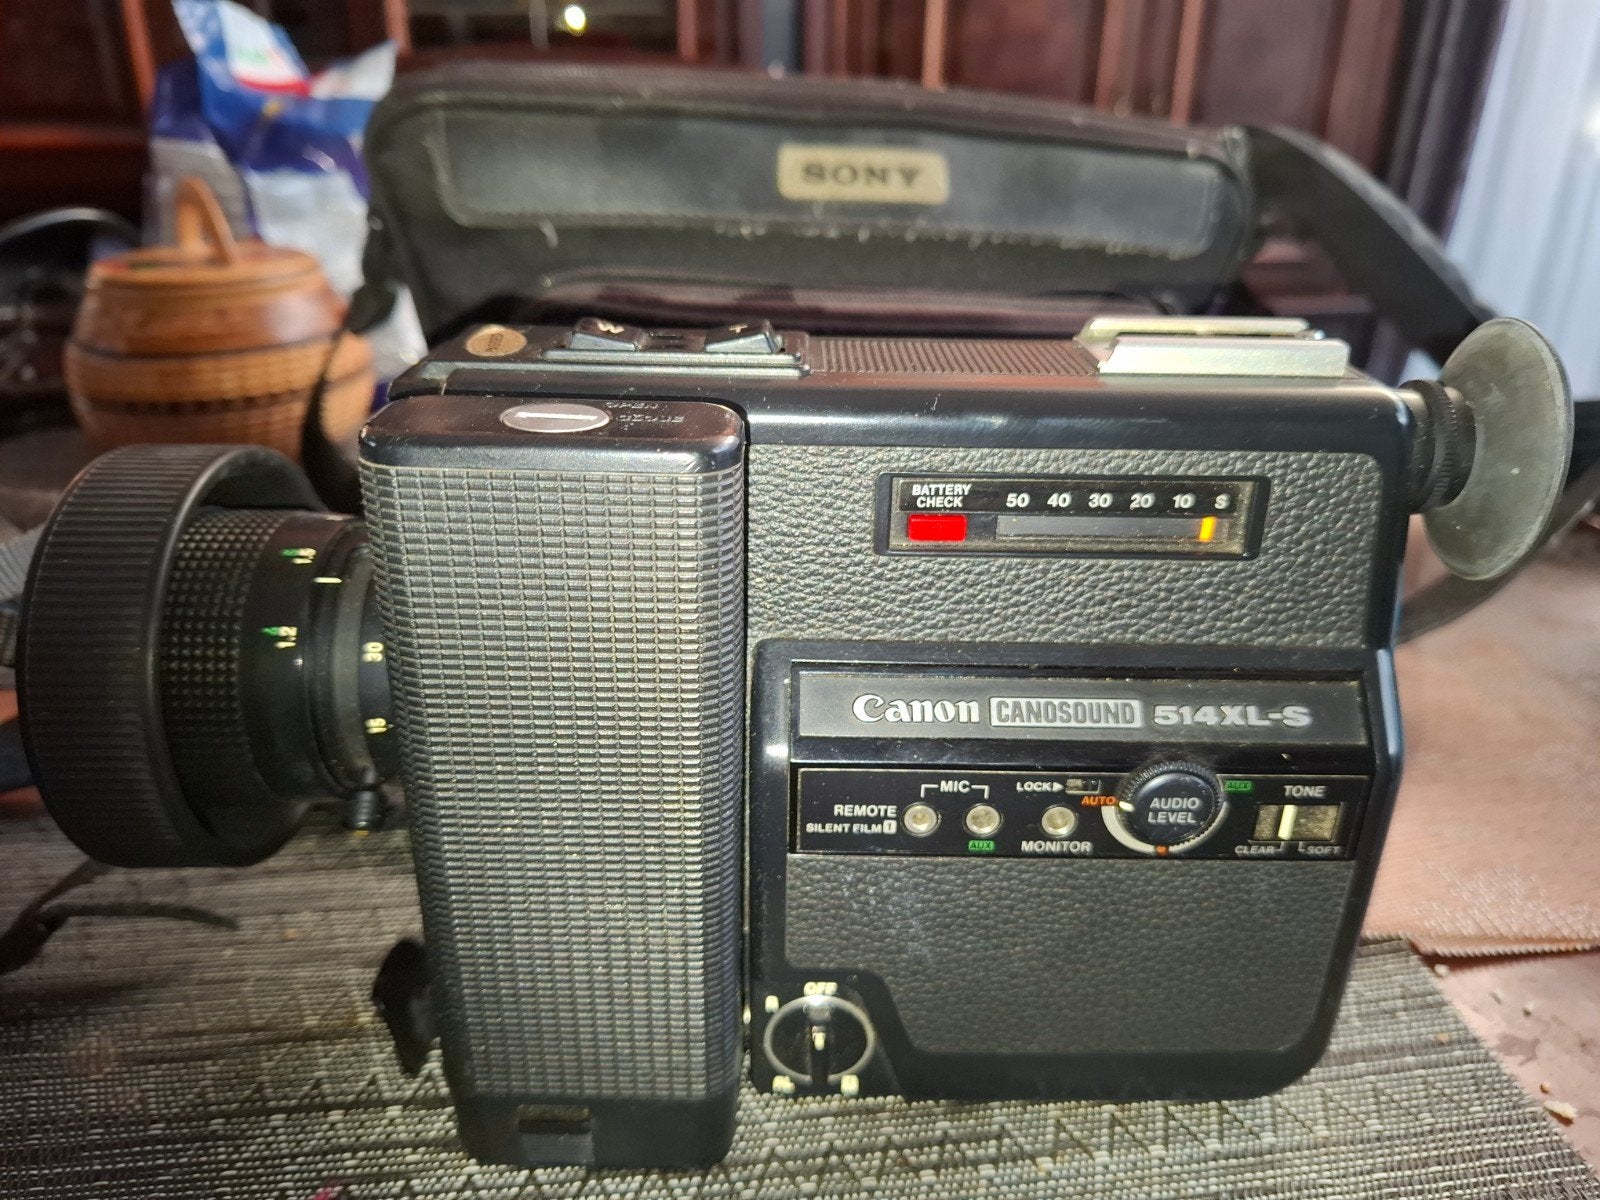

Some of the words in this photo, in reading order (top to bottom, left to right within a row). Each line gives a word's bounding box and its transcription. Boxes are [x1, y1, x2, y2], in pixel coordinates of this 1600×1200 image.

[802, 163, 921, 188] SONY
[912, 484, 971, 496] BATTERY
[916, 496, 963, 508] CHECK
[1005, 493, 1030, 508] 50
[1047, 493, 1072, 508] 40
[1088, 493, 1113, 508] 30
[1130, 493, 1156, 508] 20
[1172, 493, 1196, 508] 10
[1214, 493, 1231, 508] S
[852, 694, 980, 723] Canon
[996, 700, 1135, 725] CANOSOUND
[1153, 705, 1313, 727] 514XL-S
[940, 780, 971, 793] MIC
[1016, 781, 1053, 792] LOCK
[1284, 785, 1326, 798] TONE
[1081, 796, 1117, 806] AUTO
[1150, 797, 1201, 810] AUDIO
[834, 804, 897, 817] REMOTE
[1148, 812, 1197, 824] LEVEL
[806, 823, 850, 834] SILENT
[852, 823, 882, 834] FILM
[969, 841, 994, 851] AUX
[1021, 841, 1093, 853] MONITOR
[1235, 845, 1274, 855] CLEAR
[1306, 845, 1341, 855] SOFT
